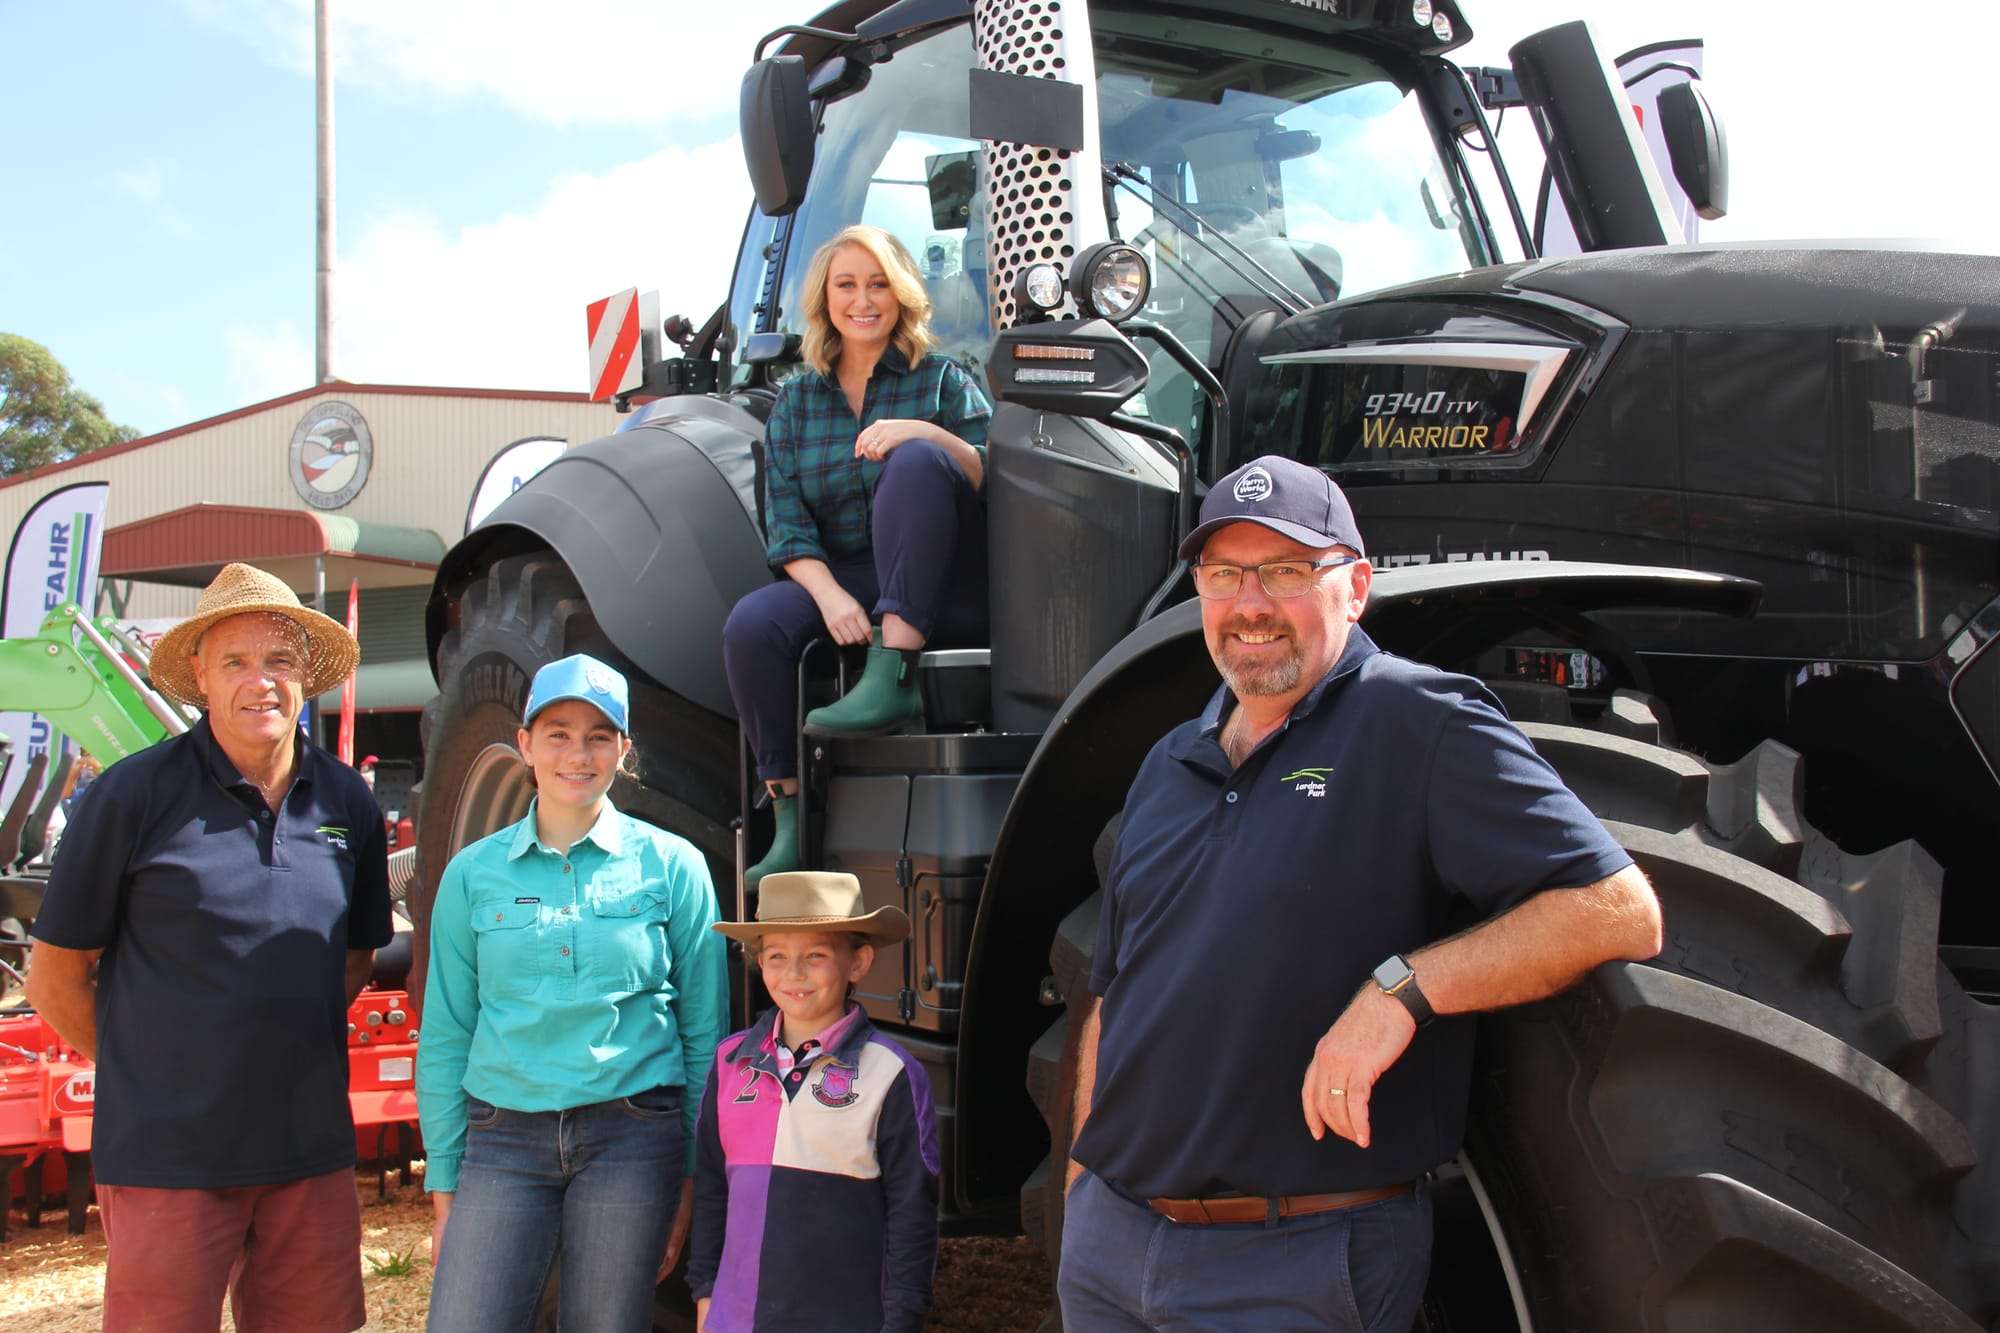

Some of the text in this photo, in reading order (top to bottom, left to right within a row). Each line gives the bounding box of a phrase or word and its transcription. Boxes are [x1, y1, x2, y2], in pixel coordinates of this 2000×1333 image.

[1364, 391, 1479, 416] 9340 TTV
[1240, 484, 1266, 494] World
[44, 521, 71, 611] FAHR
[1295, 781, 1326, 790] Lardner
